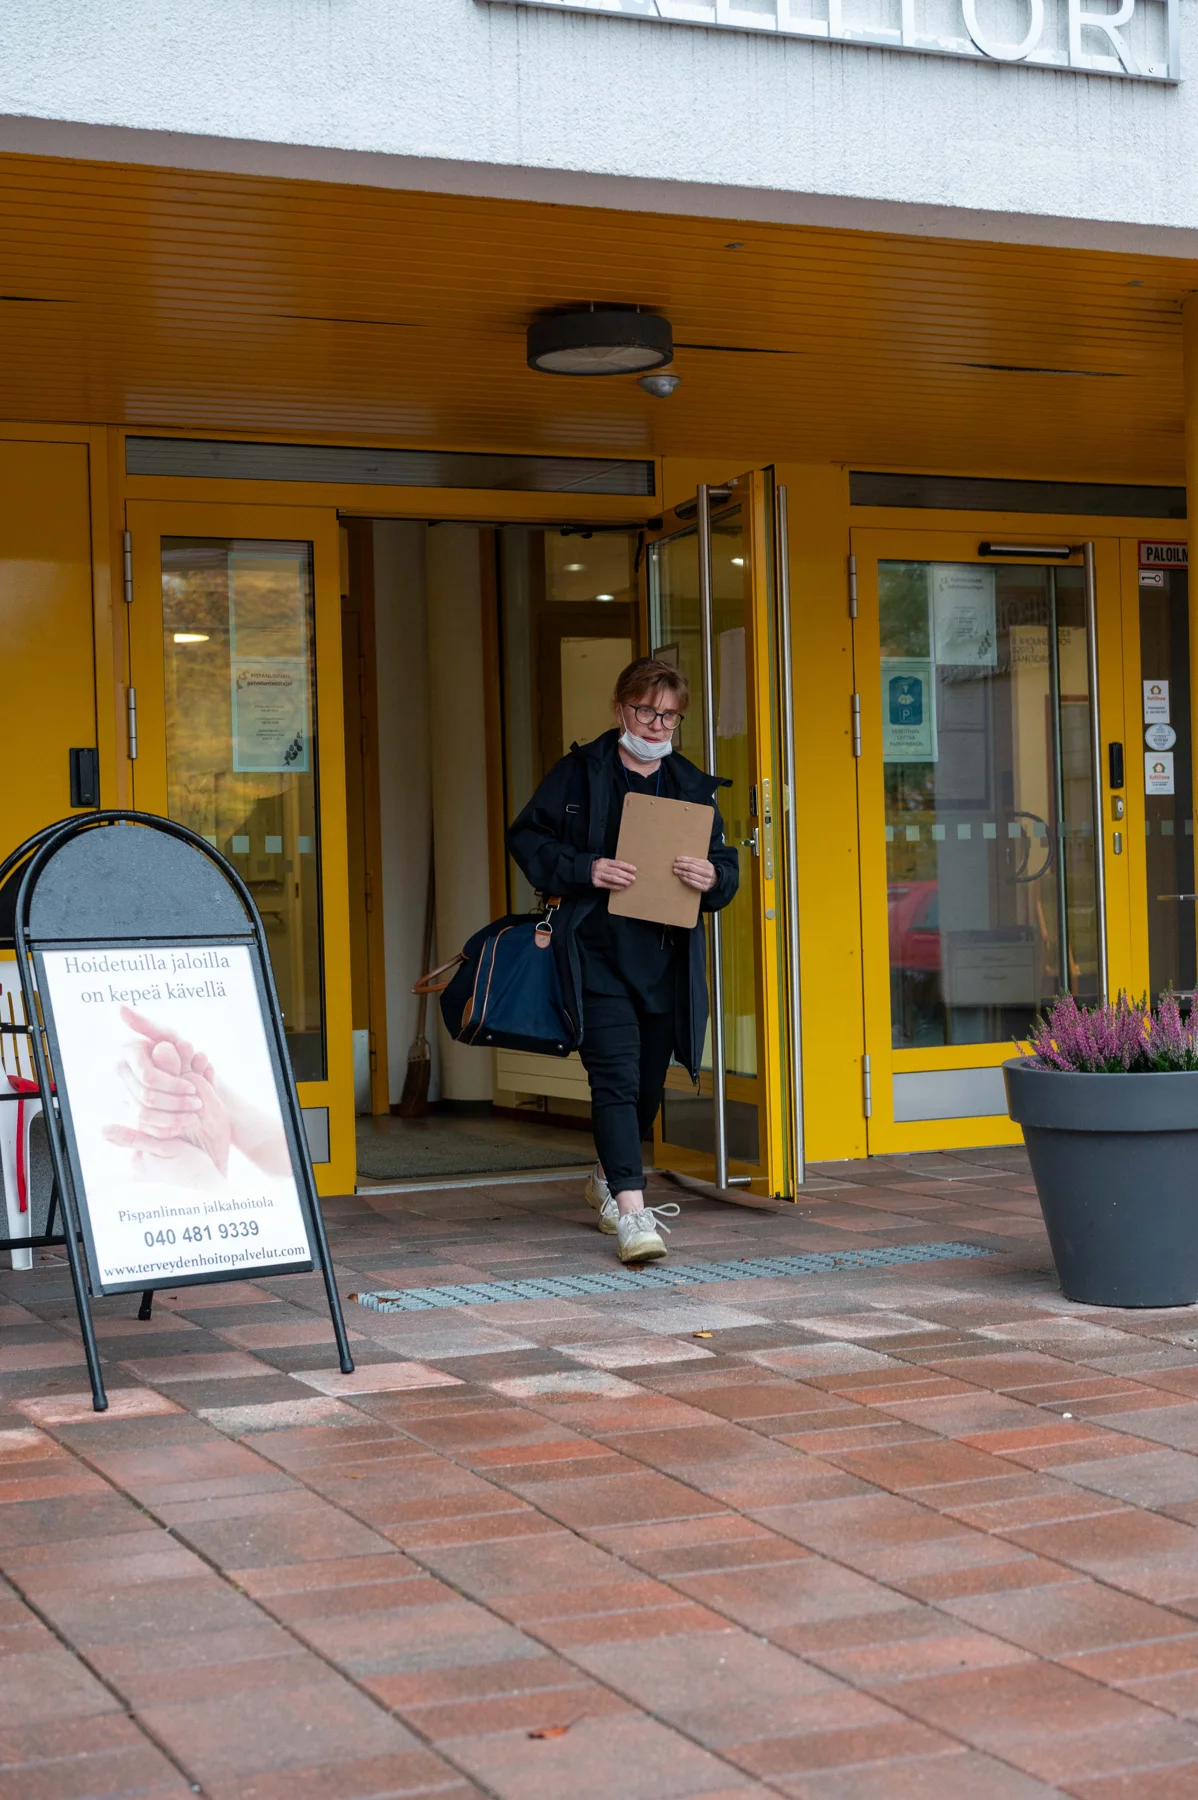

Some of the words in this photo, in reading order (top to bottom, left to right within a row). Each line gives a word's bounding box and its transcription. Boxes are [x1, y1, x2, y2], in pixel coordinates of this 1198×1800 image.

[64, 953, 168, 974] Hoidetuilla
[171, 951, 231, 975] jaloilla
[81, 990, 104, 1004] on
[108, 984, 162, 1007] kepeä
[166, 981, 227, 1000] kävellä
[118, 1204, 201, 1224] Pispanlinnan
[203, 1196, 274, 1216] jalkahoitola
[144, 1228, 176, 1247] 040
[182, 1225, 212, 1243] 481
[218, 1220, 260, 1240] 9339
[104, 1246, 306, 1278] www.terveydenhoitopalvelut.com
